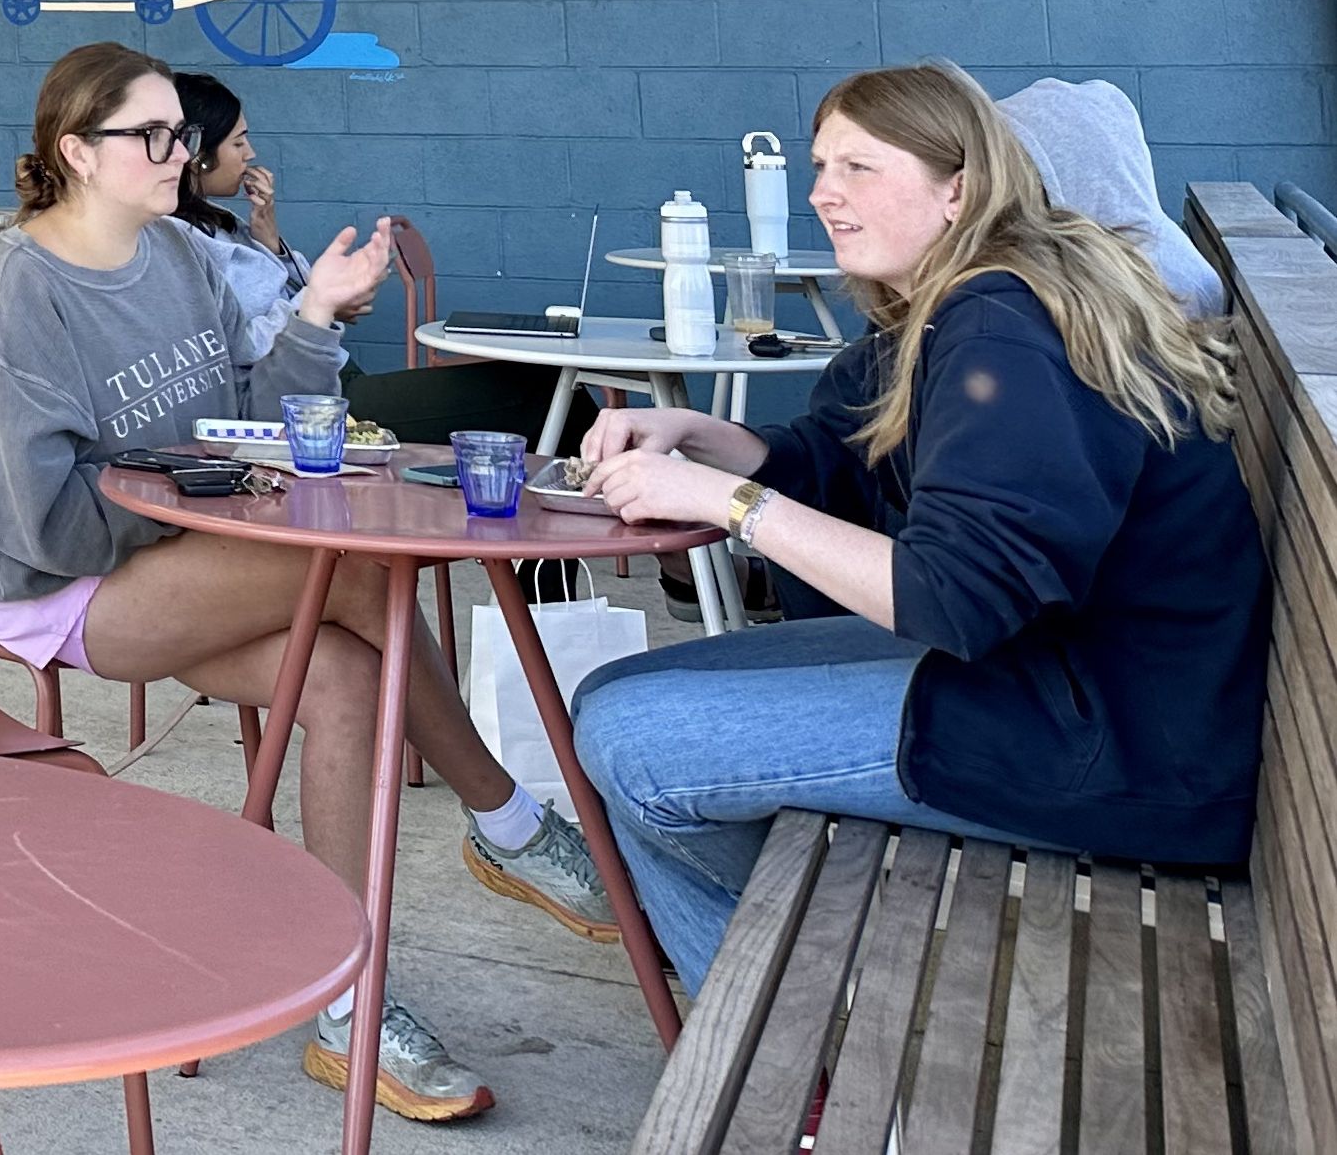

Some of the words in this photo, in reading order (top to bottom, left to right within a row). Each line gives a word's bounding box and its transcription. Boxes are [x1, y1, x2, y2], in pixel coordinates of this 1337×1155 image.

[106, 329, 226, 402] TULANE
[110, 363, 227, 439] UNIVERSIT
[470, 835, 504, 871] HOKA
